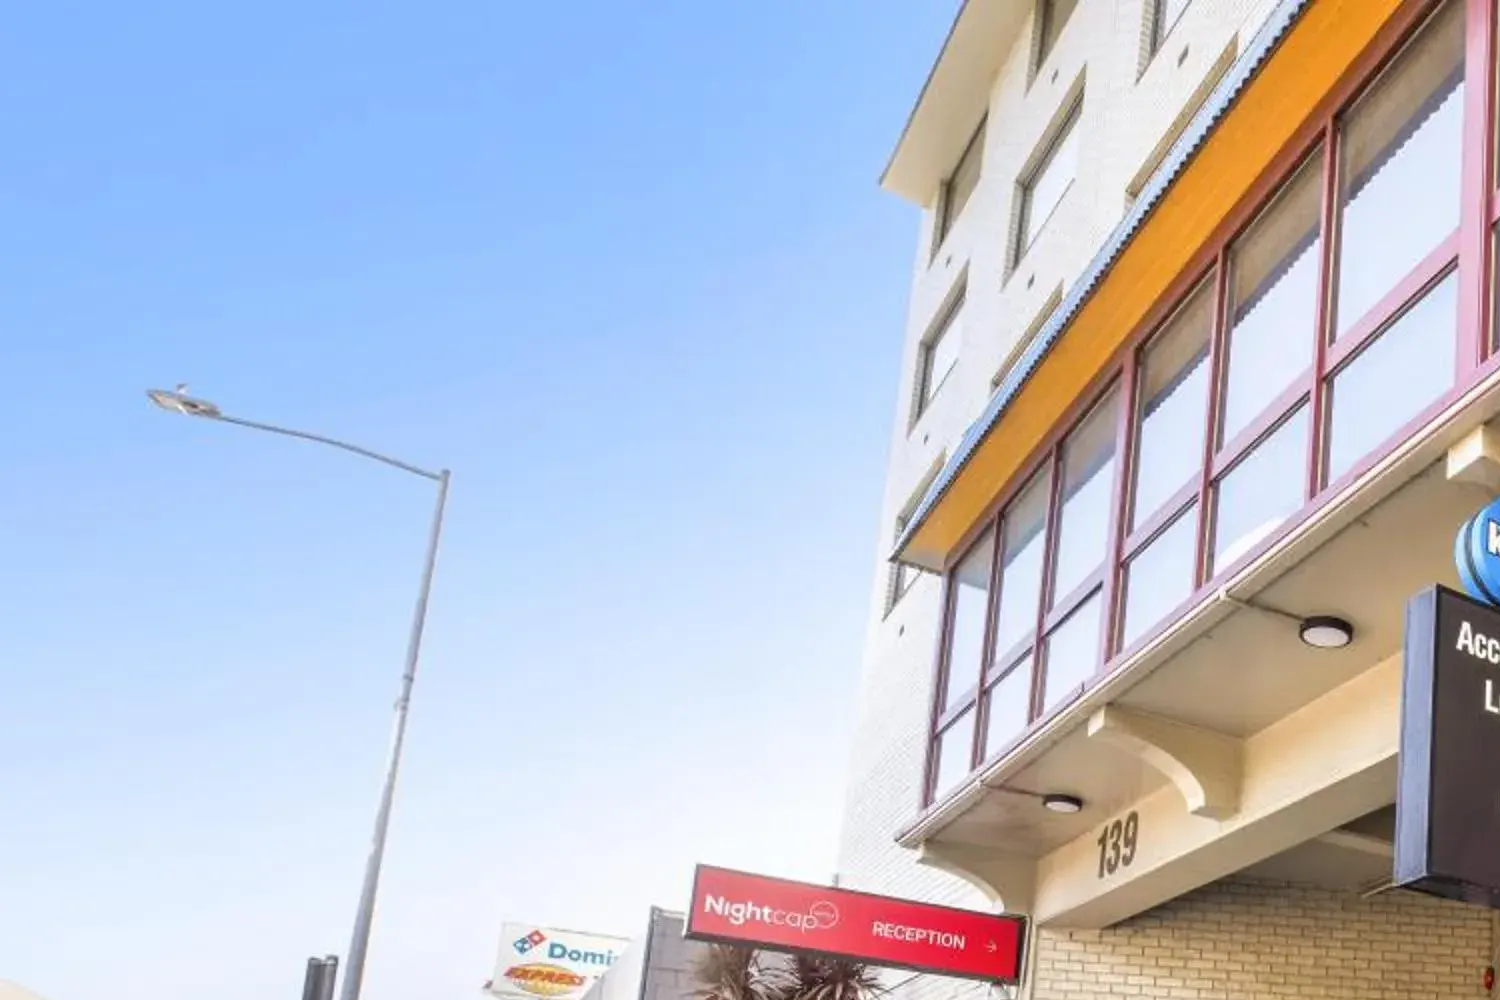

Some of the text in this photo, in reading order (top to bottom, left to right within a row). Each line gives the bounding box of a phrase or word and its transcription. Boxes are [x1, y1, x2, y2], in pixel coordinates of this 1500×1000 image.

[1097, 811, 1138, 878] 139
[704, 895, 966, 950] Nightcap RECEPTION
[548, 942, 619, 966] Domi
